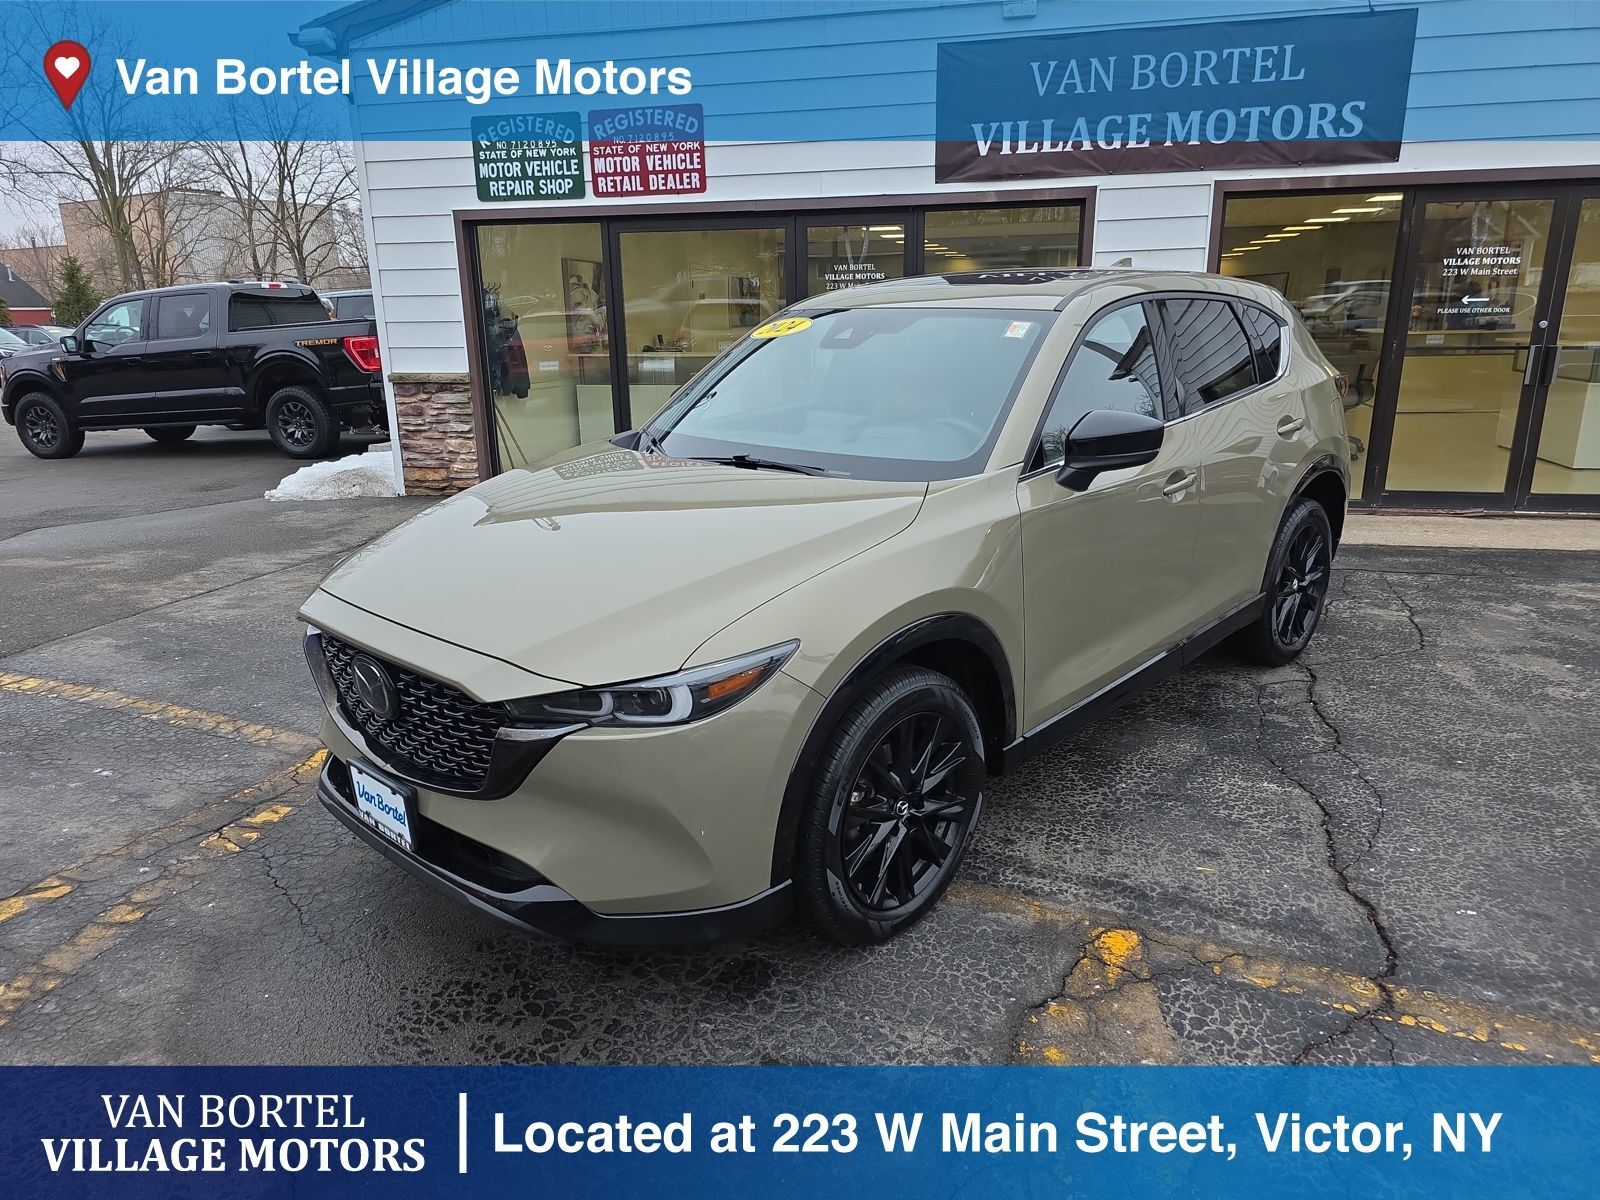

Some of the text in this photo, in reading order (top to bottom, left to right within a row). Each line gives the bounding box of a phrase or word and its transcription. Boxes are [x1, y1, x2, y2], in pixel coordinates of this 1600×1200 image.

[1030, 44, 1306, 97] VAN BORTEL
[593, 108, 699, 141] REGISTERED
[971, 100, 1366, 157] VILLAGE MOTORS
[477, 115, 575, 149] REGISTERED
[628, 132, 675, 142] 7120895
[510, 139, 557, 148] 7120895
[593, 141, 701, 155] STATE OF NEW YORK
[479, 147, 577, 160] STATE OF NEW YORK
[479, 159, 580, 179] MOTOR VEHICLE
[594, 152, 702, 174] MOTOR VEHICLE
[489, 178, 574, 197] REPAIR SHOP
[597, 172, 701, 193] RETAIL DEALER
[1456, 246, 1511, 256] VAN BORTEL
[849, 263, 876, 271] BORTEL
[1443, 256, 1522, 266] VILLAGE MOTORS
[855, 272, 885, 280] MOTORS
[1442, 267, 1518, 276] 223 W Main Street
[295, 338, 338, 347] TREMOR
